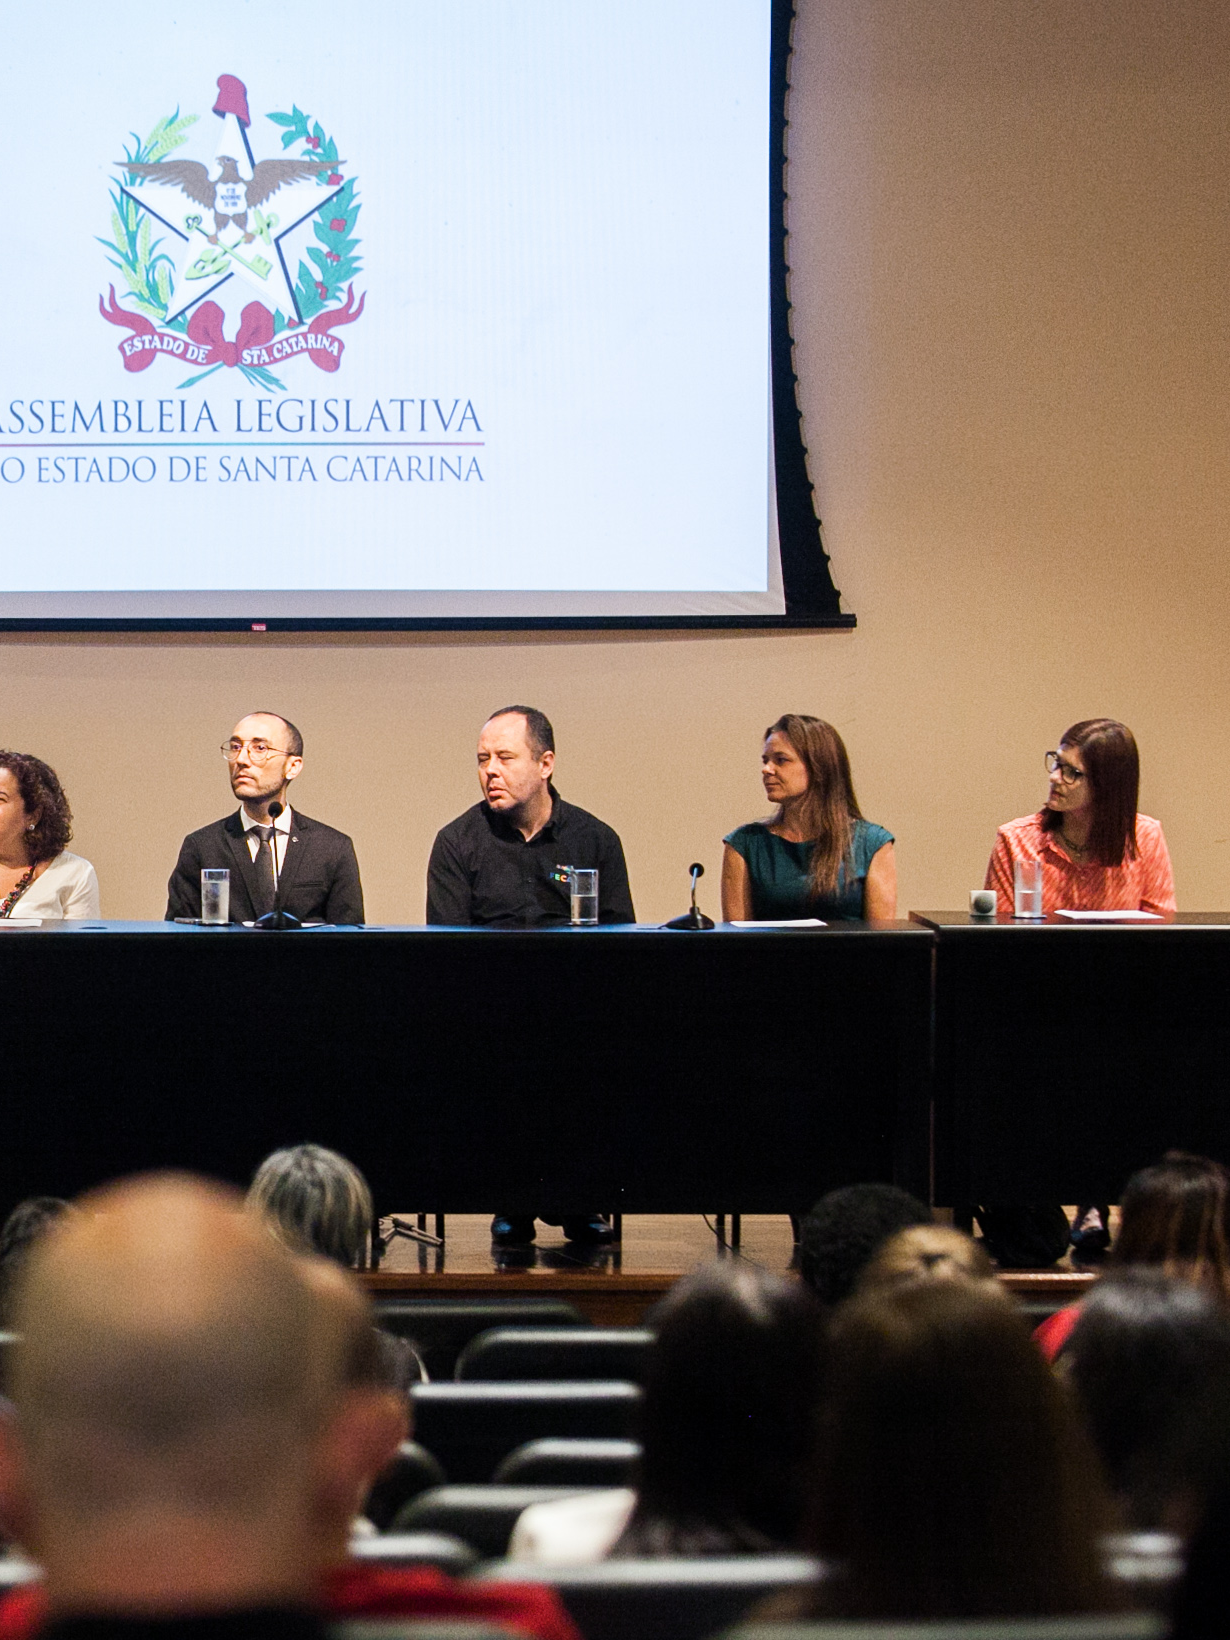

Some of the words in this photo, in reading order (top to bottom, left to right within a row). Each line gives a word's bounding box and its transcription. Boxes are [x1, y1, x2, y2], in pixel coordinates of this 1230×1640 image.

[122, 333, 185, 357] ESTADO
[185, 345, 209, 364] DE
[272, 333, 341, 359] CATARINA
[235, 398, 484, 434] LEGISLATIVA
[37, 455, 157, 484] ESTADO
[168, 455, 208, 483] DE
[218, 455, 318, 483] SANTA
[326, 455, 486, 483] CATARINA
